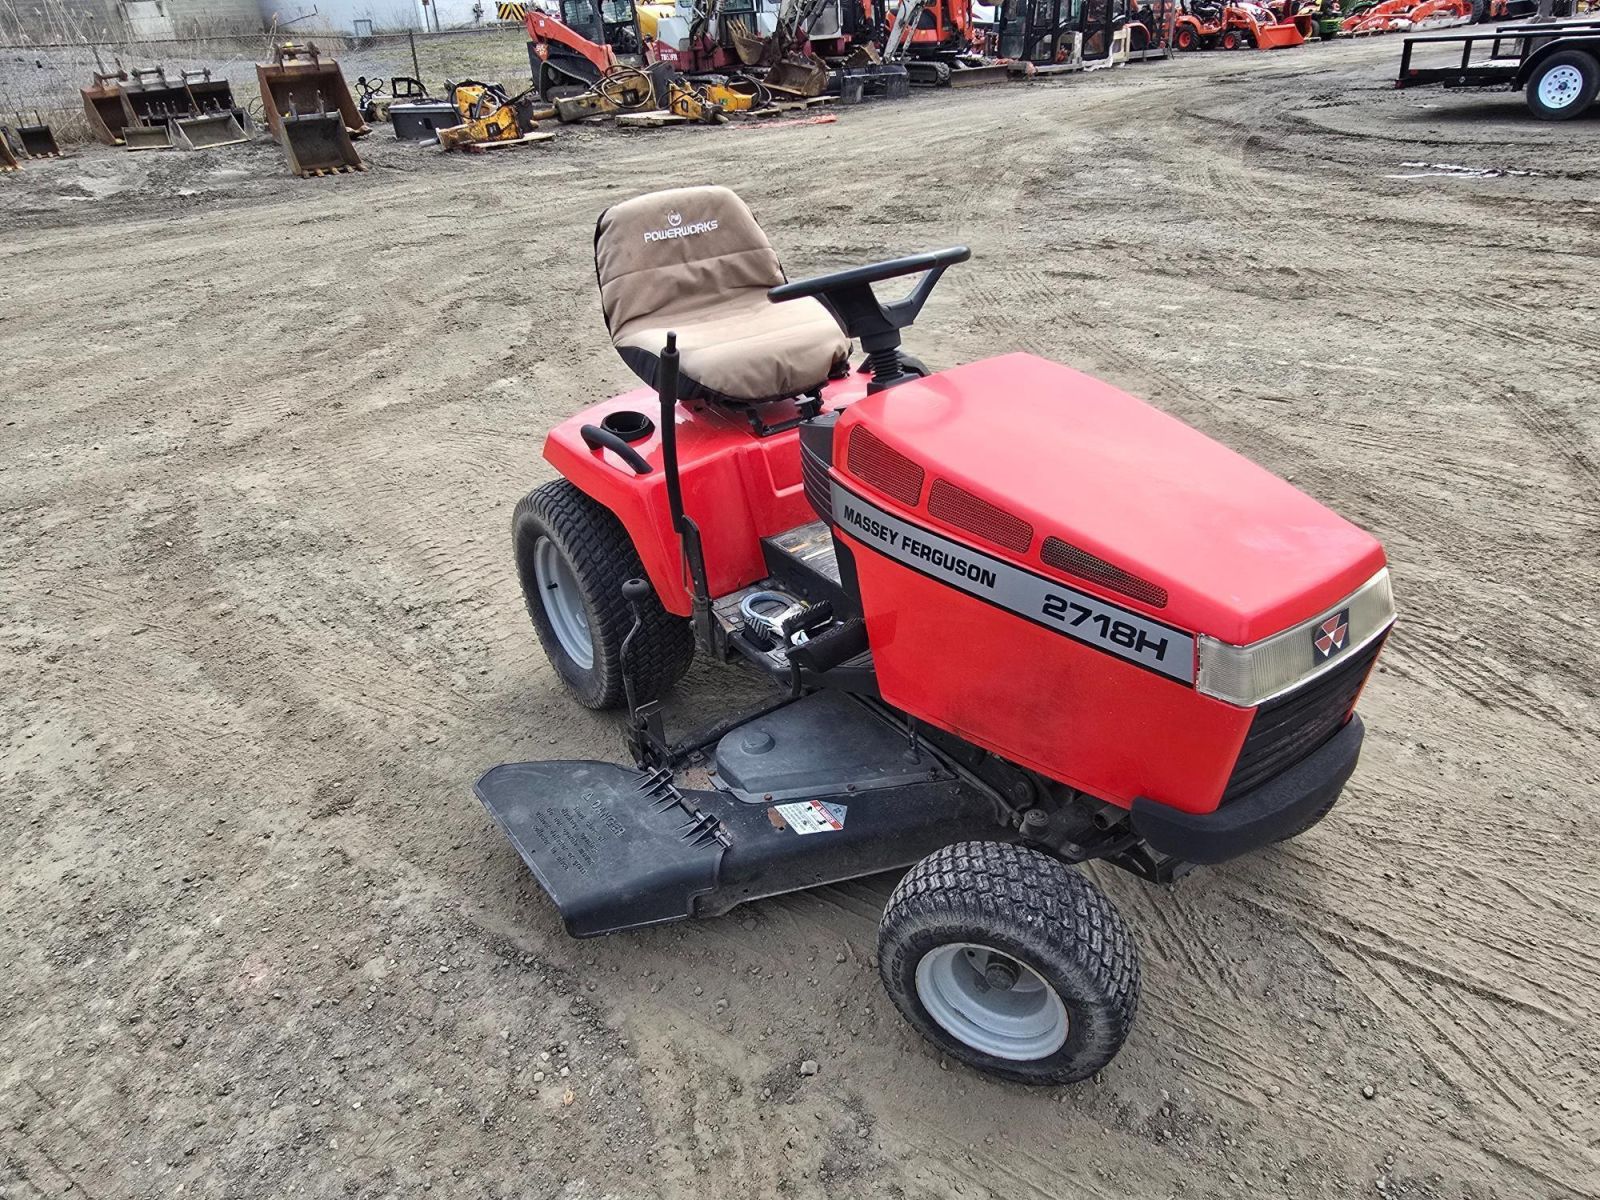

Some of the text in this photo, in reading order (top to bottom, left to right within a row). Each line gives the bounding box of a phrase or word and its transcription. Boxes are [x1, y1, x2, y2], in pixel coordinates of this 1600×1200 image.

[644, 220, 718, 243] POWERWORKS
[843, 505, 1168, 661] MASSEY FERGUSON 2718H
[592, 800, 626, 838] DANGER
